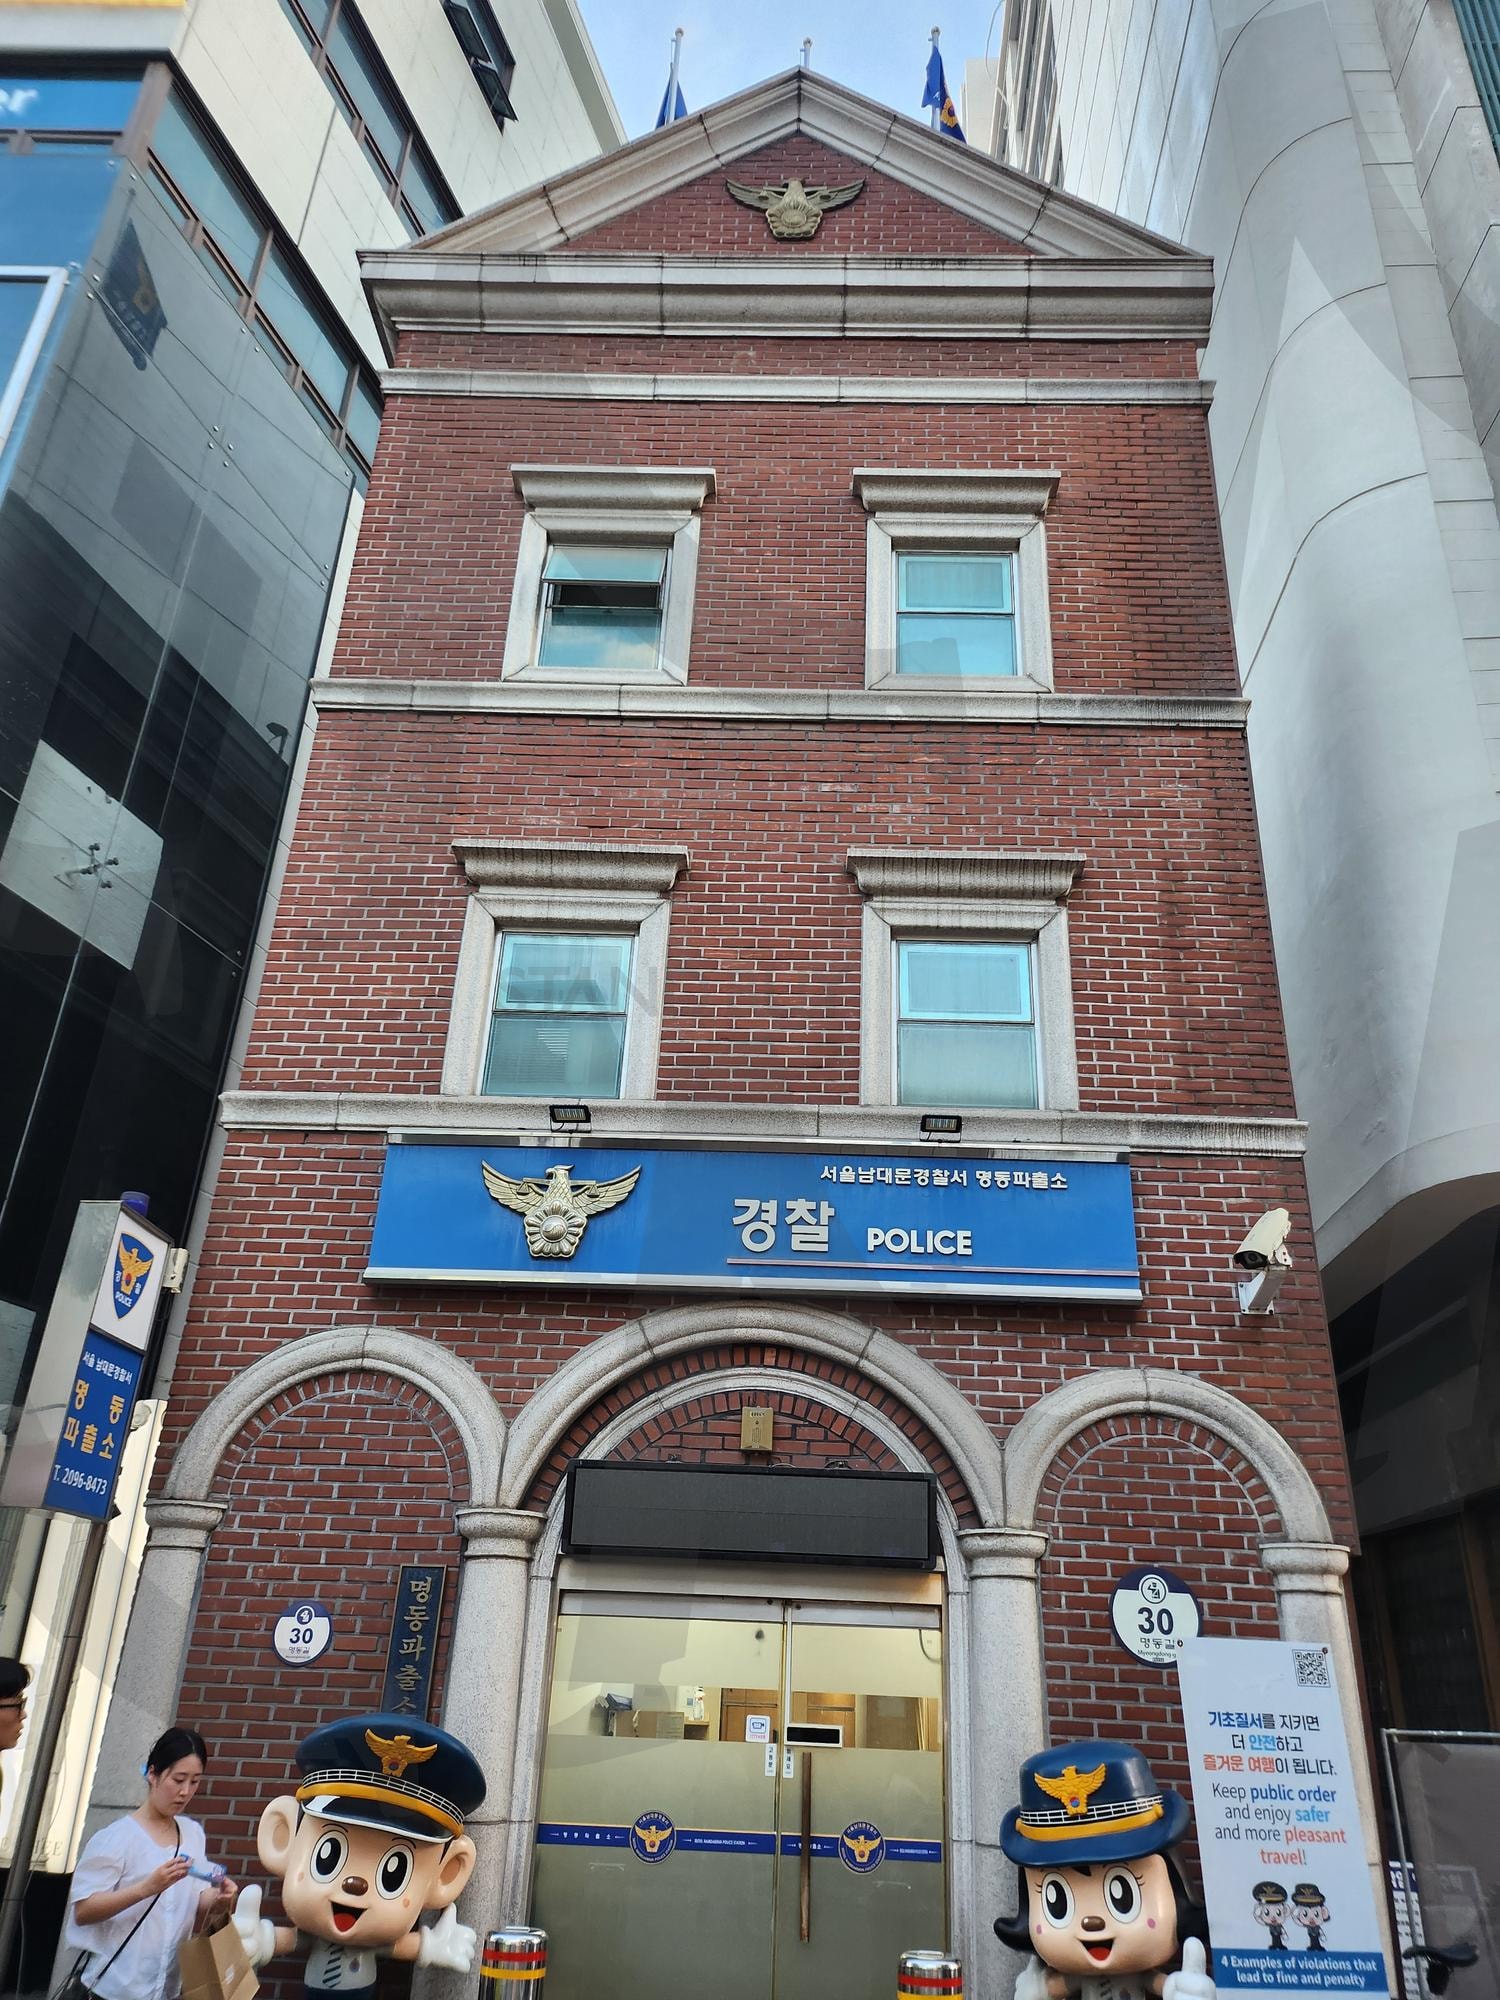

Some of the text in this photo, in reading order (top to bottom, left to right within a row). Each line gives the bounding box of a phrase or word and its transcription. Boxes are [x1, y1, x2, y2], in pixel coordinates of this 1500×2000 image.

[820, 1165, 1068, 1190] 서울남대문경찰서 명동파출소
[732, 1198, 834, 1253] 경찰
[867, 1227, 972, 1255] POLICE
[82, 1351, 133, 1385] 서울 남대문경찰서
[63, 1416, 115, 1460] 파출소
[53, 1464, 107, 1495] T. 2096-8473
[1137, 1606, 1174, 1636] 30
[289, 1627, 314, 1644] 30
[1208, 1711, 1320, 1731] 기초질서를 지키면
[1232, 1734, 1304, 1752] 더 안전하고
[1203, 1754, 1338, 1776] 즐거운 여행이 됩니다.
[1212, 1783, 1337, 1803] Keep public order
[1225, 1803, 1331, 1826] and enjoy safer
[1215, 1825, 1347, 1844] and more pleasant
[1260, 1848, 1307, 1866] travel!
[1221, 1955, 1377, 1972] 4 Examples of violations that
[1237, 1970, 1365, 1988] lead to fine and penalty
